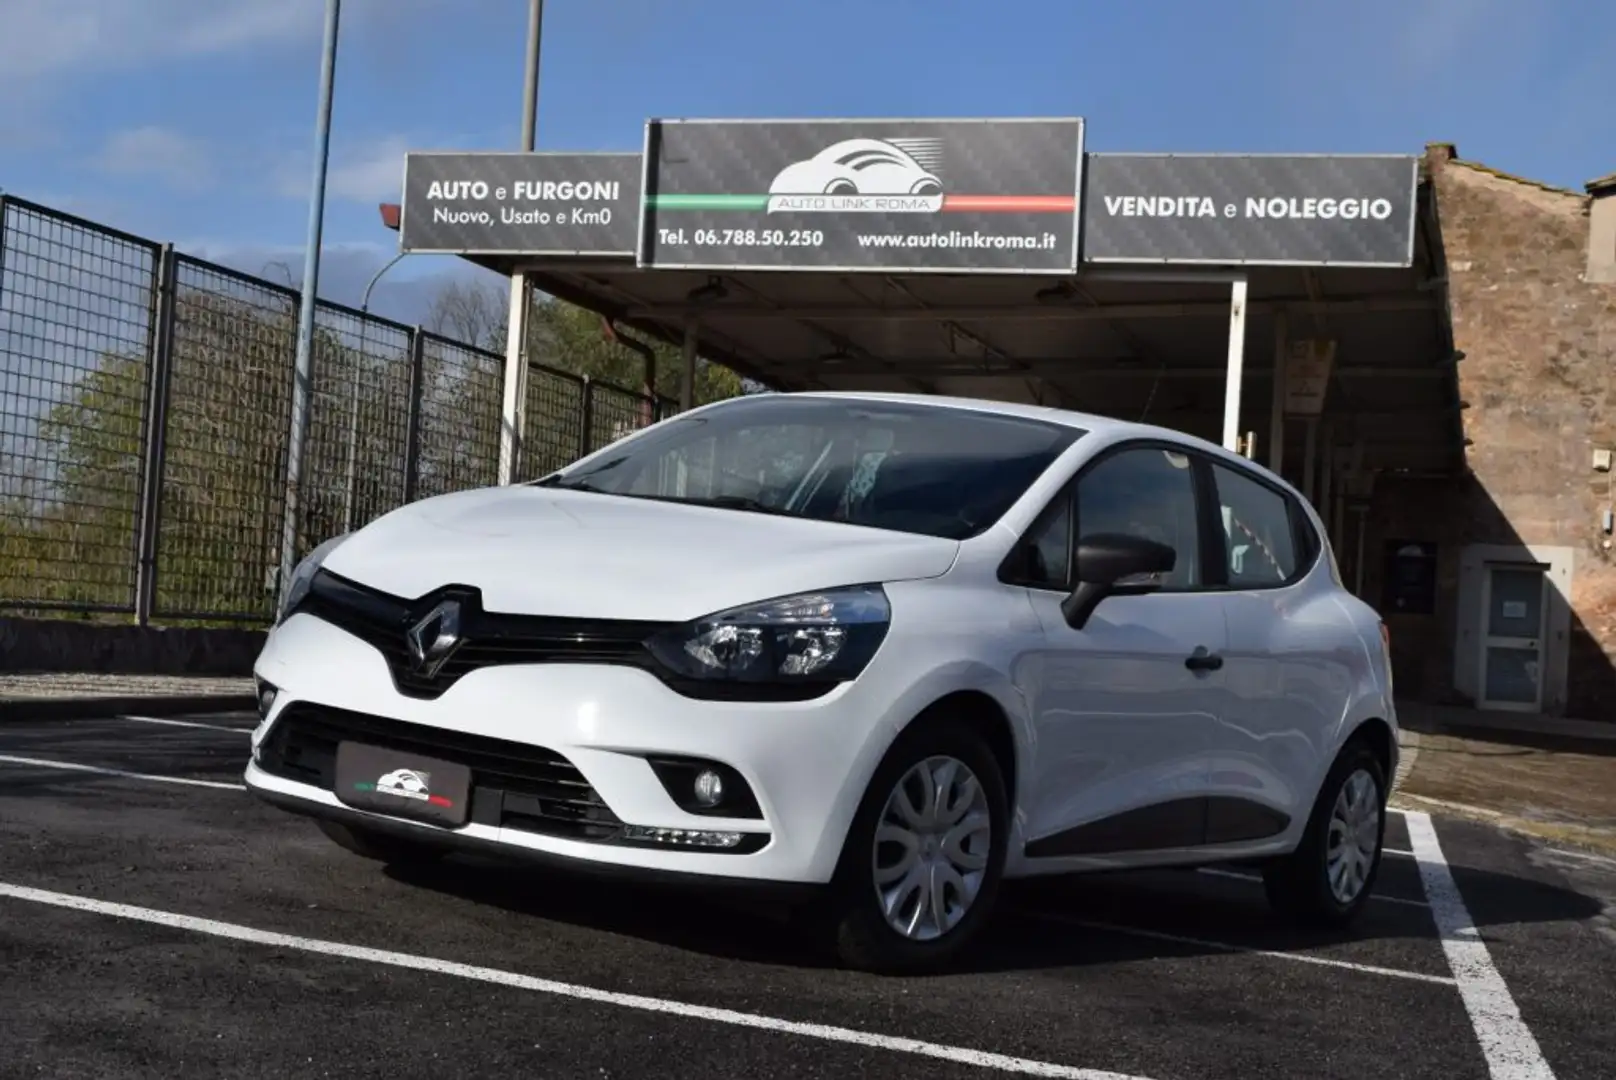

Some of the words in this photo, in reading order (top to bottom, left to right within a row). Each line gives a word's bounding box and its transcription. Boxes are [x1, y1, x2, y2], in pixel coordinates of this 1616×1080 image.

[426, 180, 489, 200] AUTO
[495, 186, 507, 200] e
[513, 181, 620, 200] FURGONI
[778, 198, 825, 209] AUTO
[832, 199, 869, 209] LINK
[875, 199, 931, 210] ROMA
[1103, 195, 1217, 217] VENDITA
[1223, 203, 1237, 218] e
[1245, 197, 1393, 219] NOLEGGIO
[433, 207, 494, 227] Nuovo,
[500, 207, 550, 225] Usato
[555, 212, 566, 225] e
[571, 207, 612, 225] Km0
[658, 228, 689, 245] Tel.
[694, 229, 824, 246] 06.788.50.250
[857, 231, 1057, 249] www.autolinkroma.it
